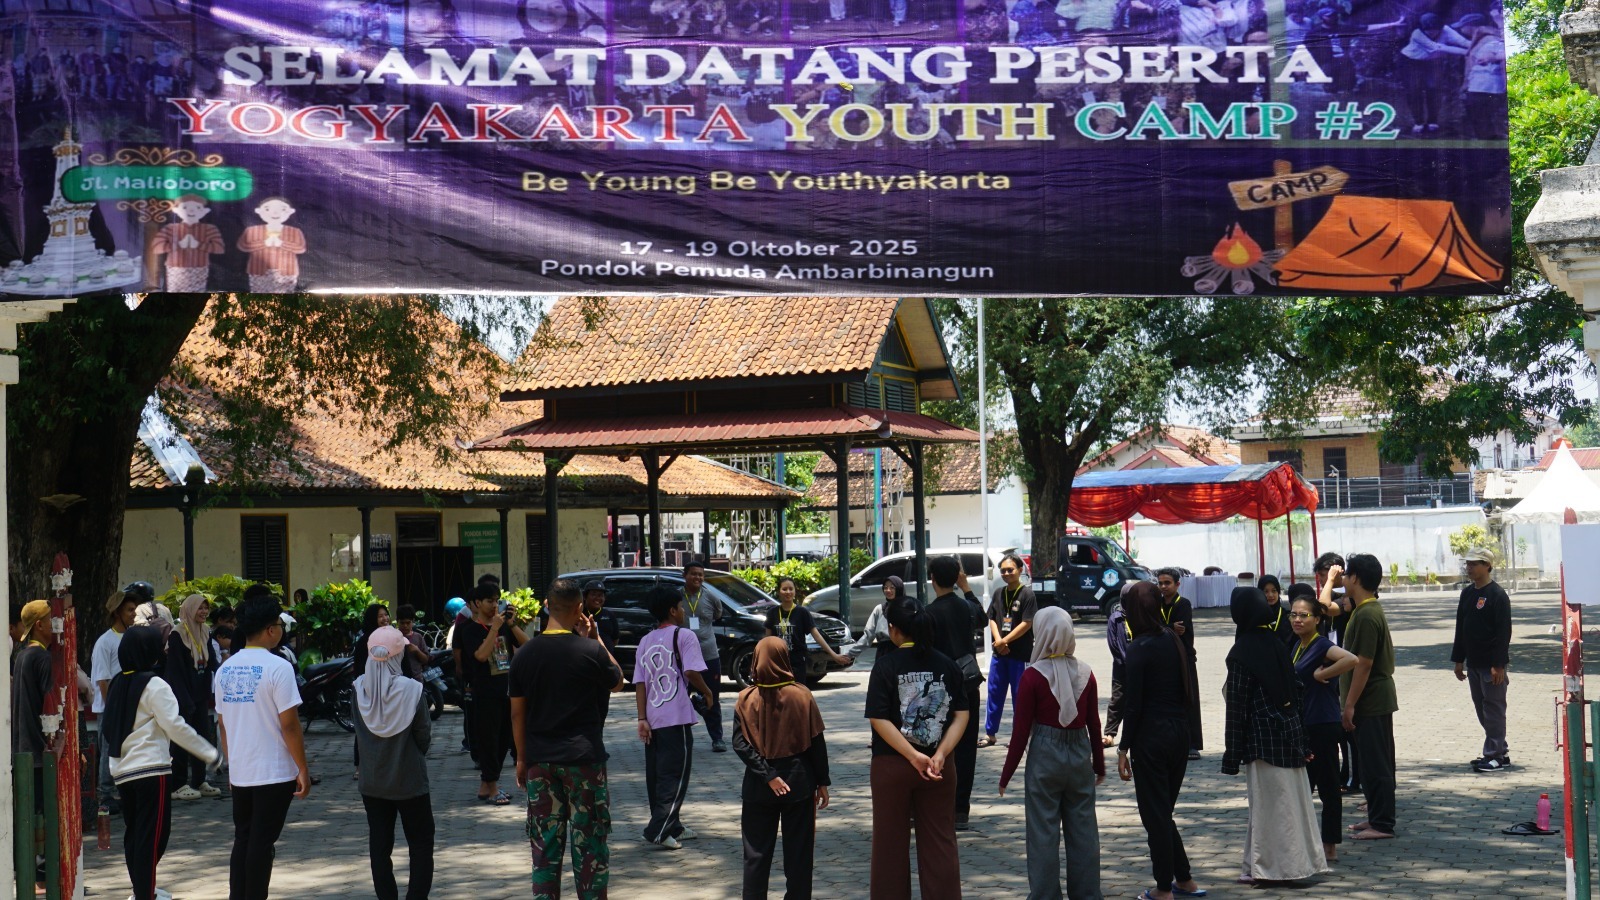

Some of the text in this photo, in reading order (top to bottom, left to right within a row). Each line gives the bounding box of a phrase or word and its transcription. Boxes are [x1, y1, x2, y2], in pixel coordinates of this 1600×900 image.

[223, 46, 1332, 86] SELAMAT DATANG PESERTA
[166, 98, 1400, 143] YOGYAKARTA YOUTH CAMP #2
[80, 176, 236, 191] Jl. Malioboro
[522, 170, 1010, 195] Be Young Be Youthyakarta
[1247, 172, 1328, 203] CAMP
[620, 241, 652, 255] 17
[685, 241, 718, 256] 19
[728, 240, 840, 256] Oktober
[849, 240, 918, 256] 2025
[541, 260, 994, 281] Pondok Pemuda Ambarbinangun
[640, 644, 679, 708] B
